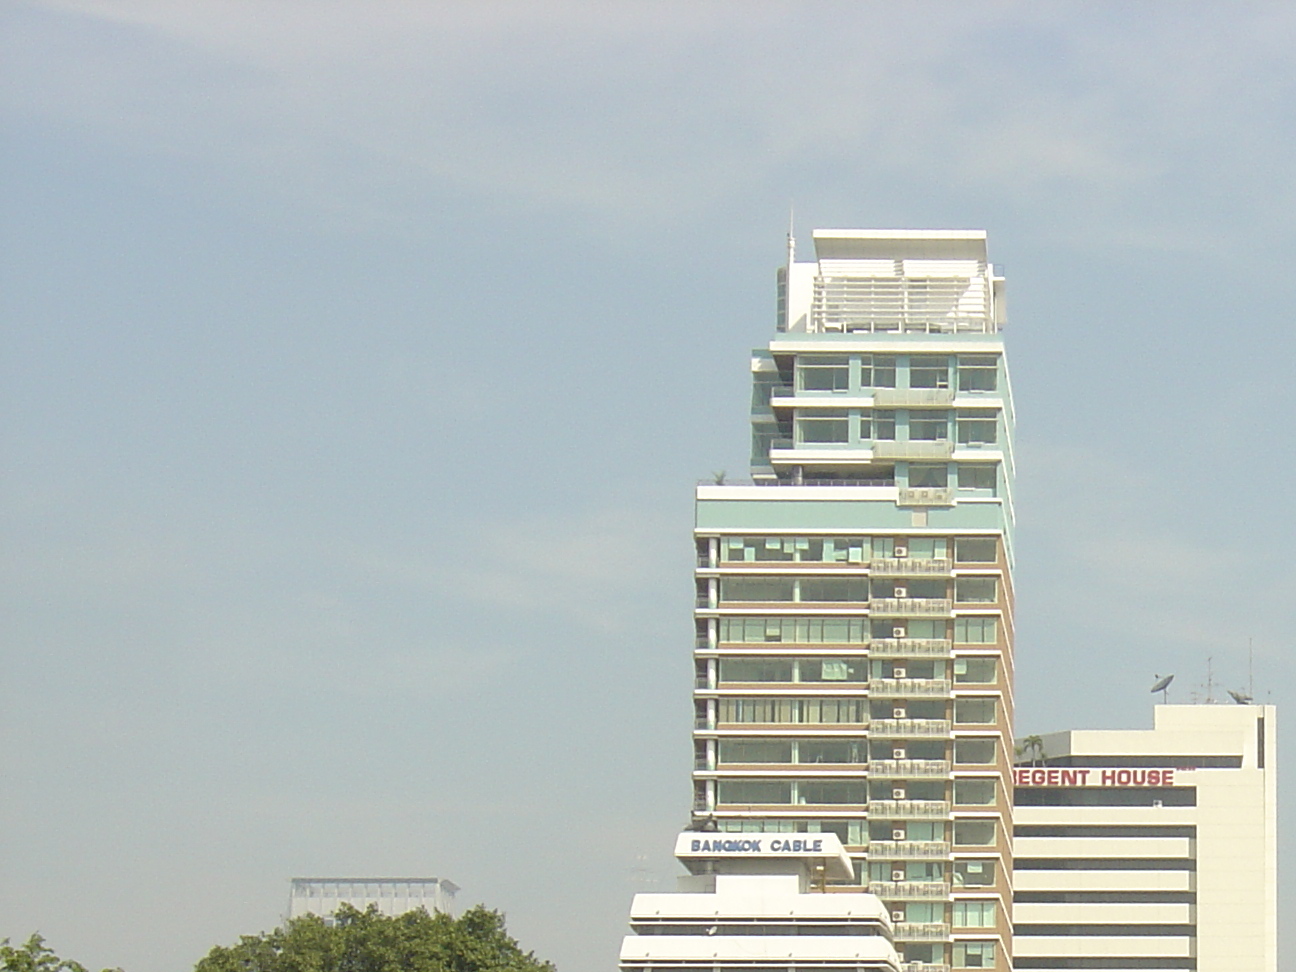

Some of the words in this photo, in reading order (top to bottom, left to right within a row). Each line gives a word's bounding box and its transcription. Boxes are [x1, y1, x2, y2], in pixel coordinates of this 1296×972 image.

[1101, 769, 1174, 785] HOUSE
[691, 839, 762, 852] BANGKOK
[770, 839, 823, 852] CABLE
